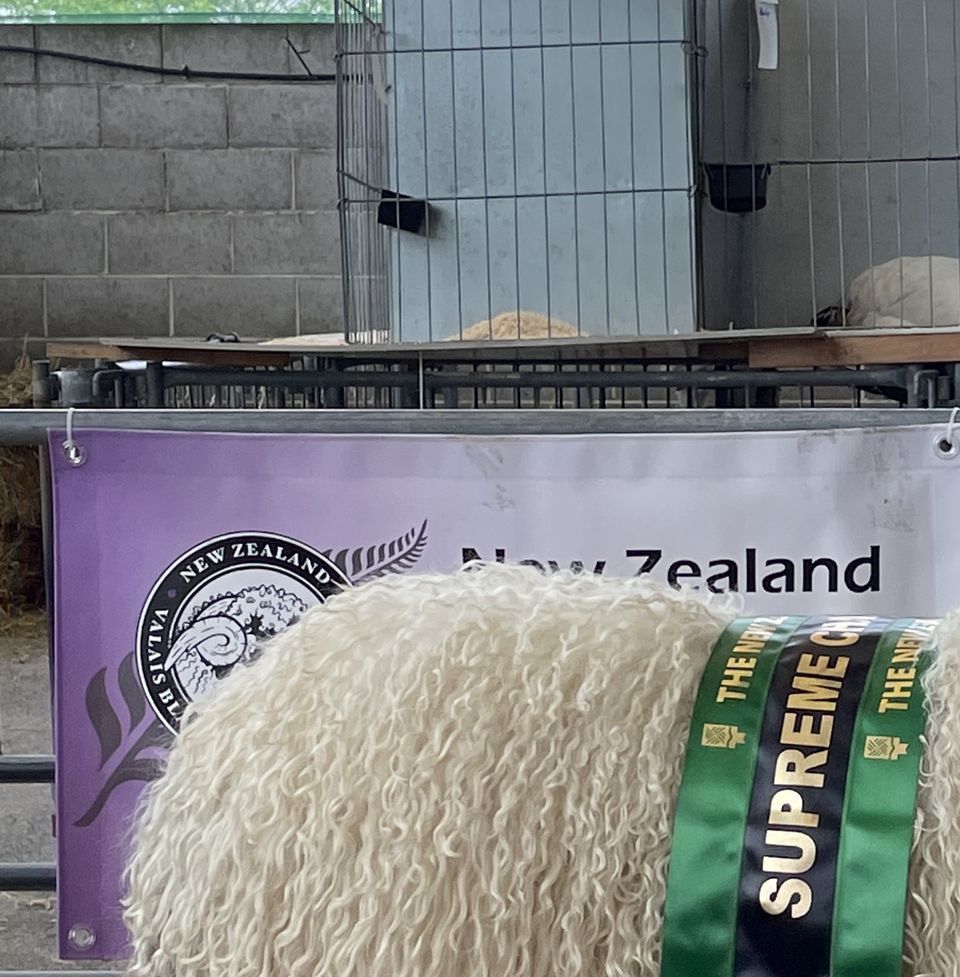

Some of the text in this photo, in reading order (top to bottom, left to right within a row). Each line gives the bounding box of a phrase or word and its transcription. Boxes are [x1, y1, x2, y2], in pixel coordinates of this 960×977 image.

[179, 542, 332, 586] NEW ZEALAND
[625, 545, 882, 594] Zealand
[147, 607, 170, 685] VALAIS
[715, 656, 758, 703] THE
[878, 664, 918, 713] THE
[758, 653, 850, 919] SUPREME
